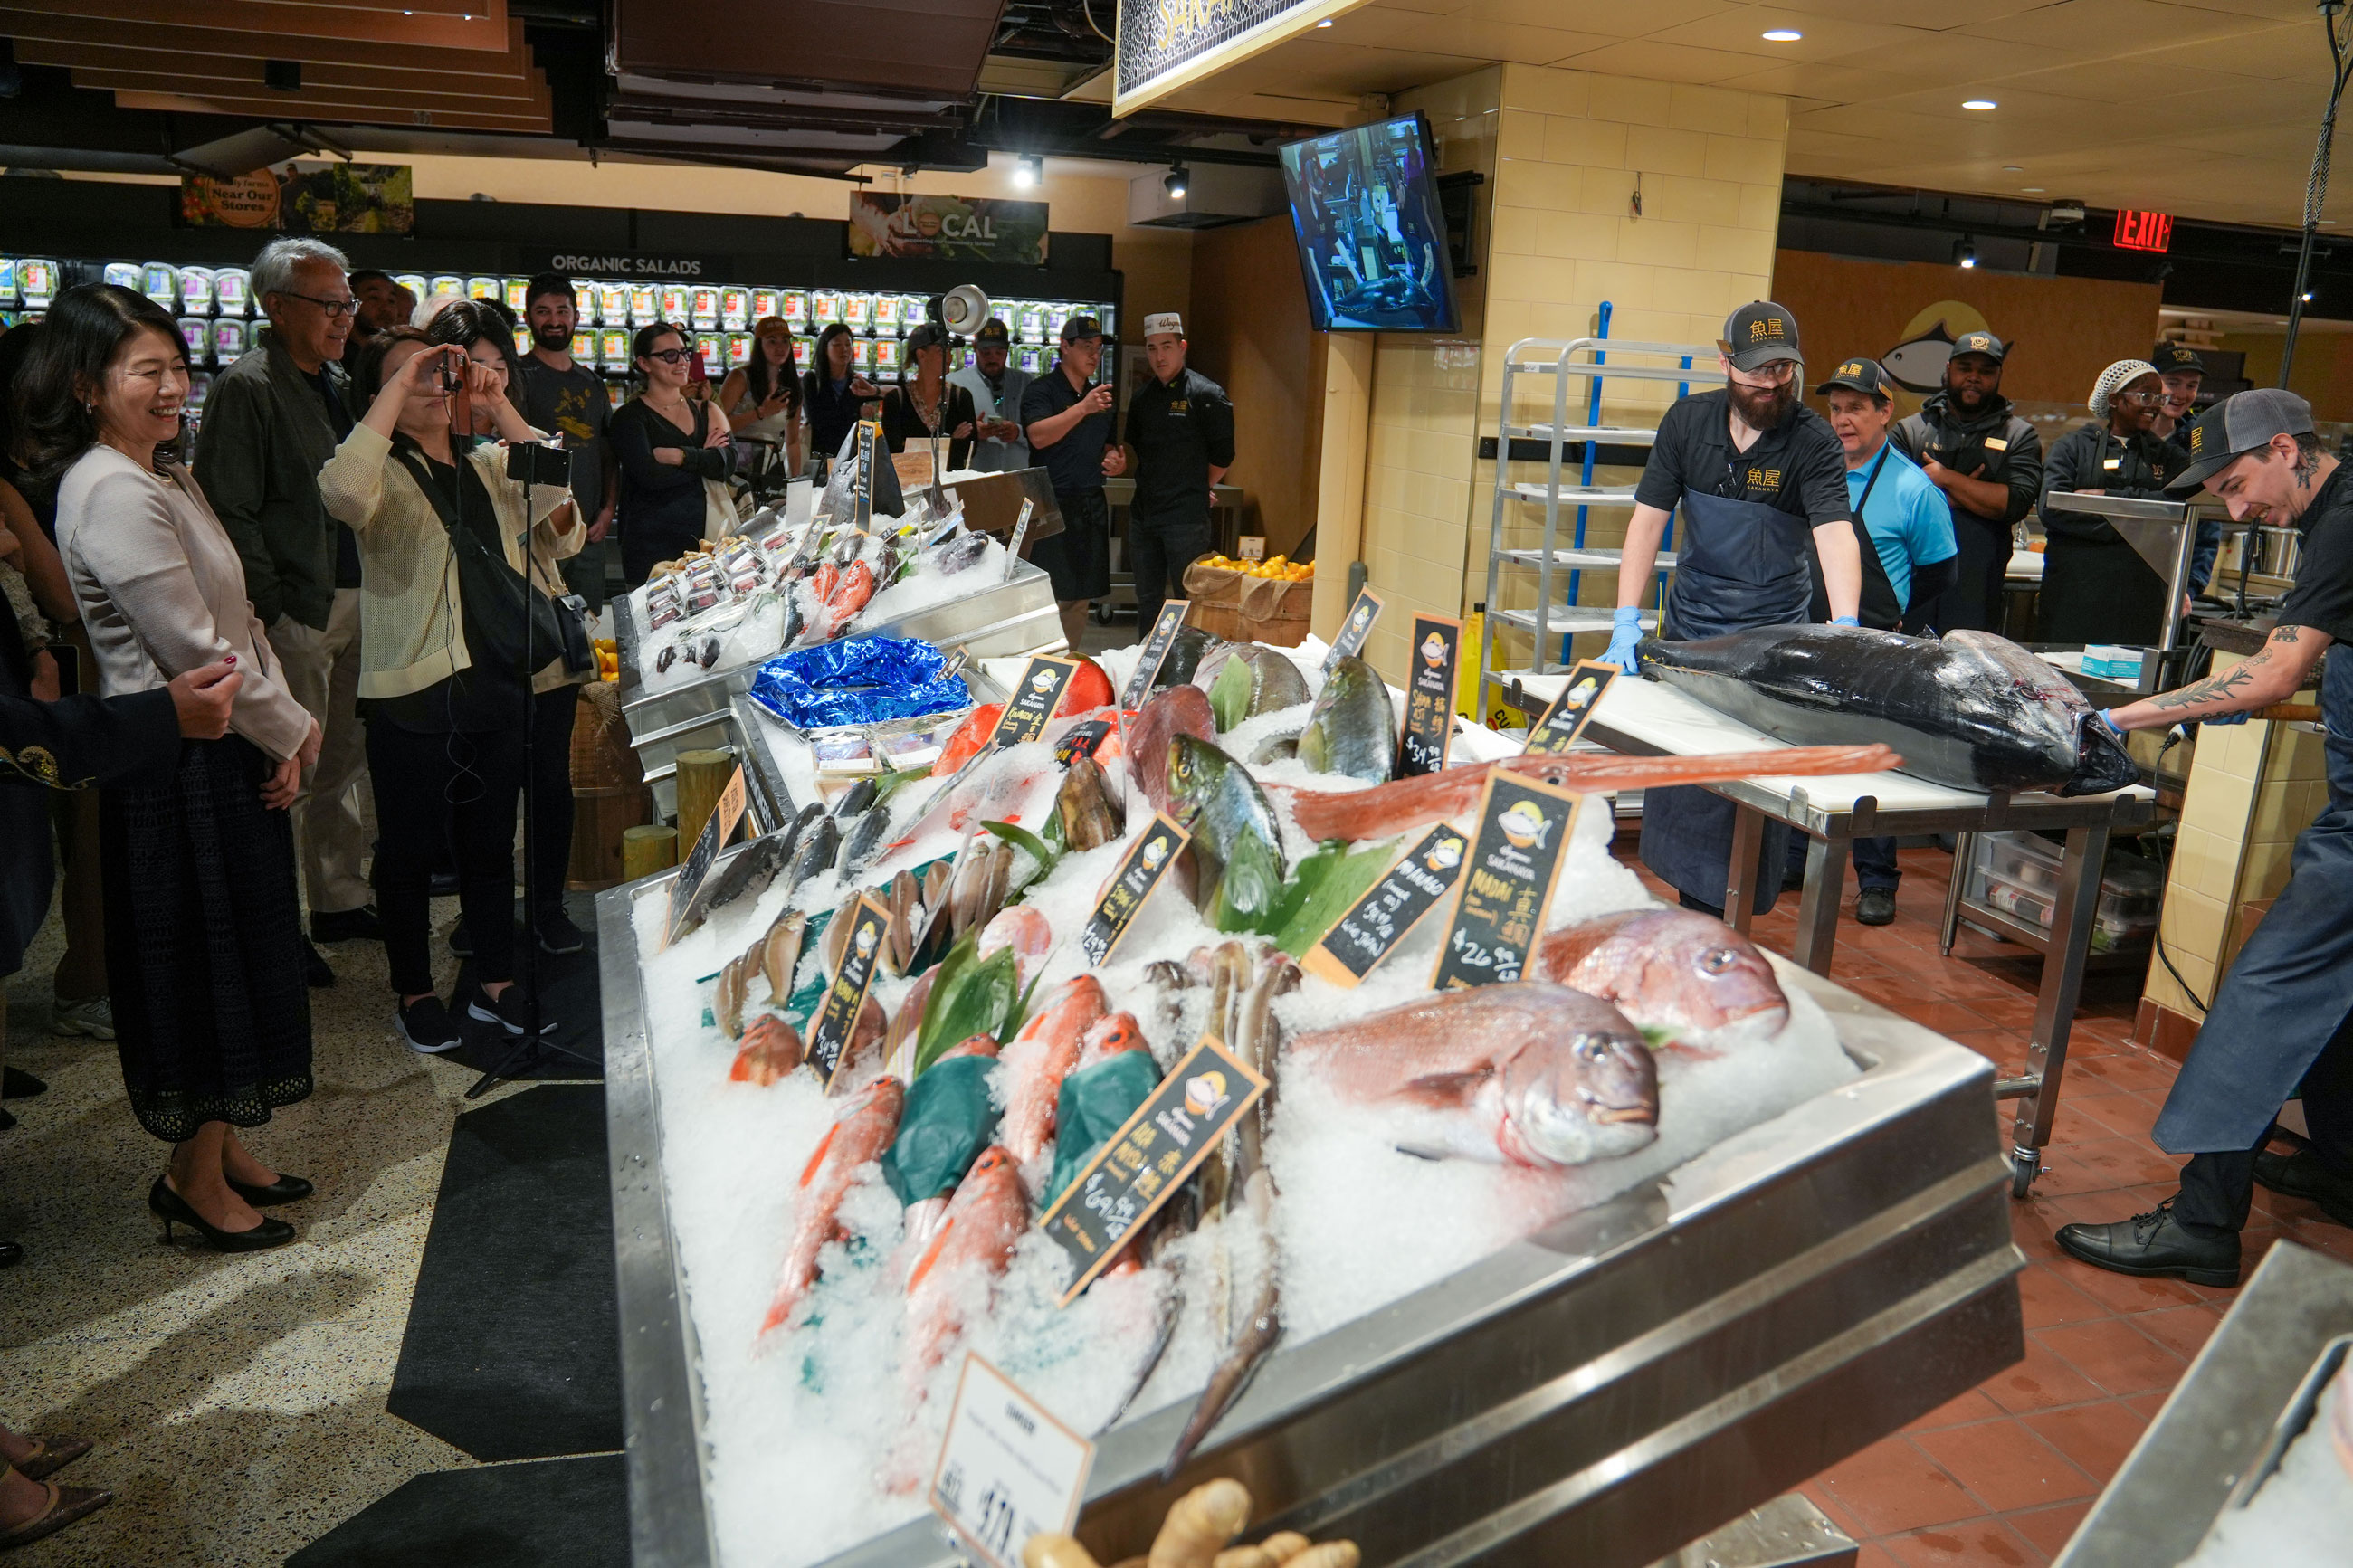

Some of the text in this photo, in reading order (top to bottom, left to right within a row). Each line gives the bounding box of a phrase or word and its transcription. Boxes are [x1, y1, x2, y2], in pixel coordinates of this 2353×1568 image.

[212, 187, 273, 200] Near Our
[220, 200, 265, 212] Stores
[551, 254, 701, 275] ORGANIC SALADS
[1749, 318, 1784, 339] 魚屋
[1747, 467, 1780, 487] 魚屋
[1494, 708, 1512, 728] CU
[1486, 853, 1536, 881] SAKANAYA
[1453, 927, 1493, 967] $26
[1085, 1172, 1115, 1218] $69
